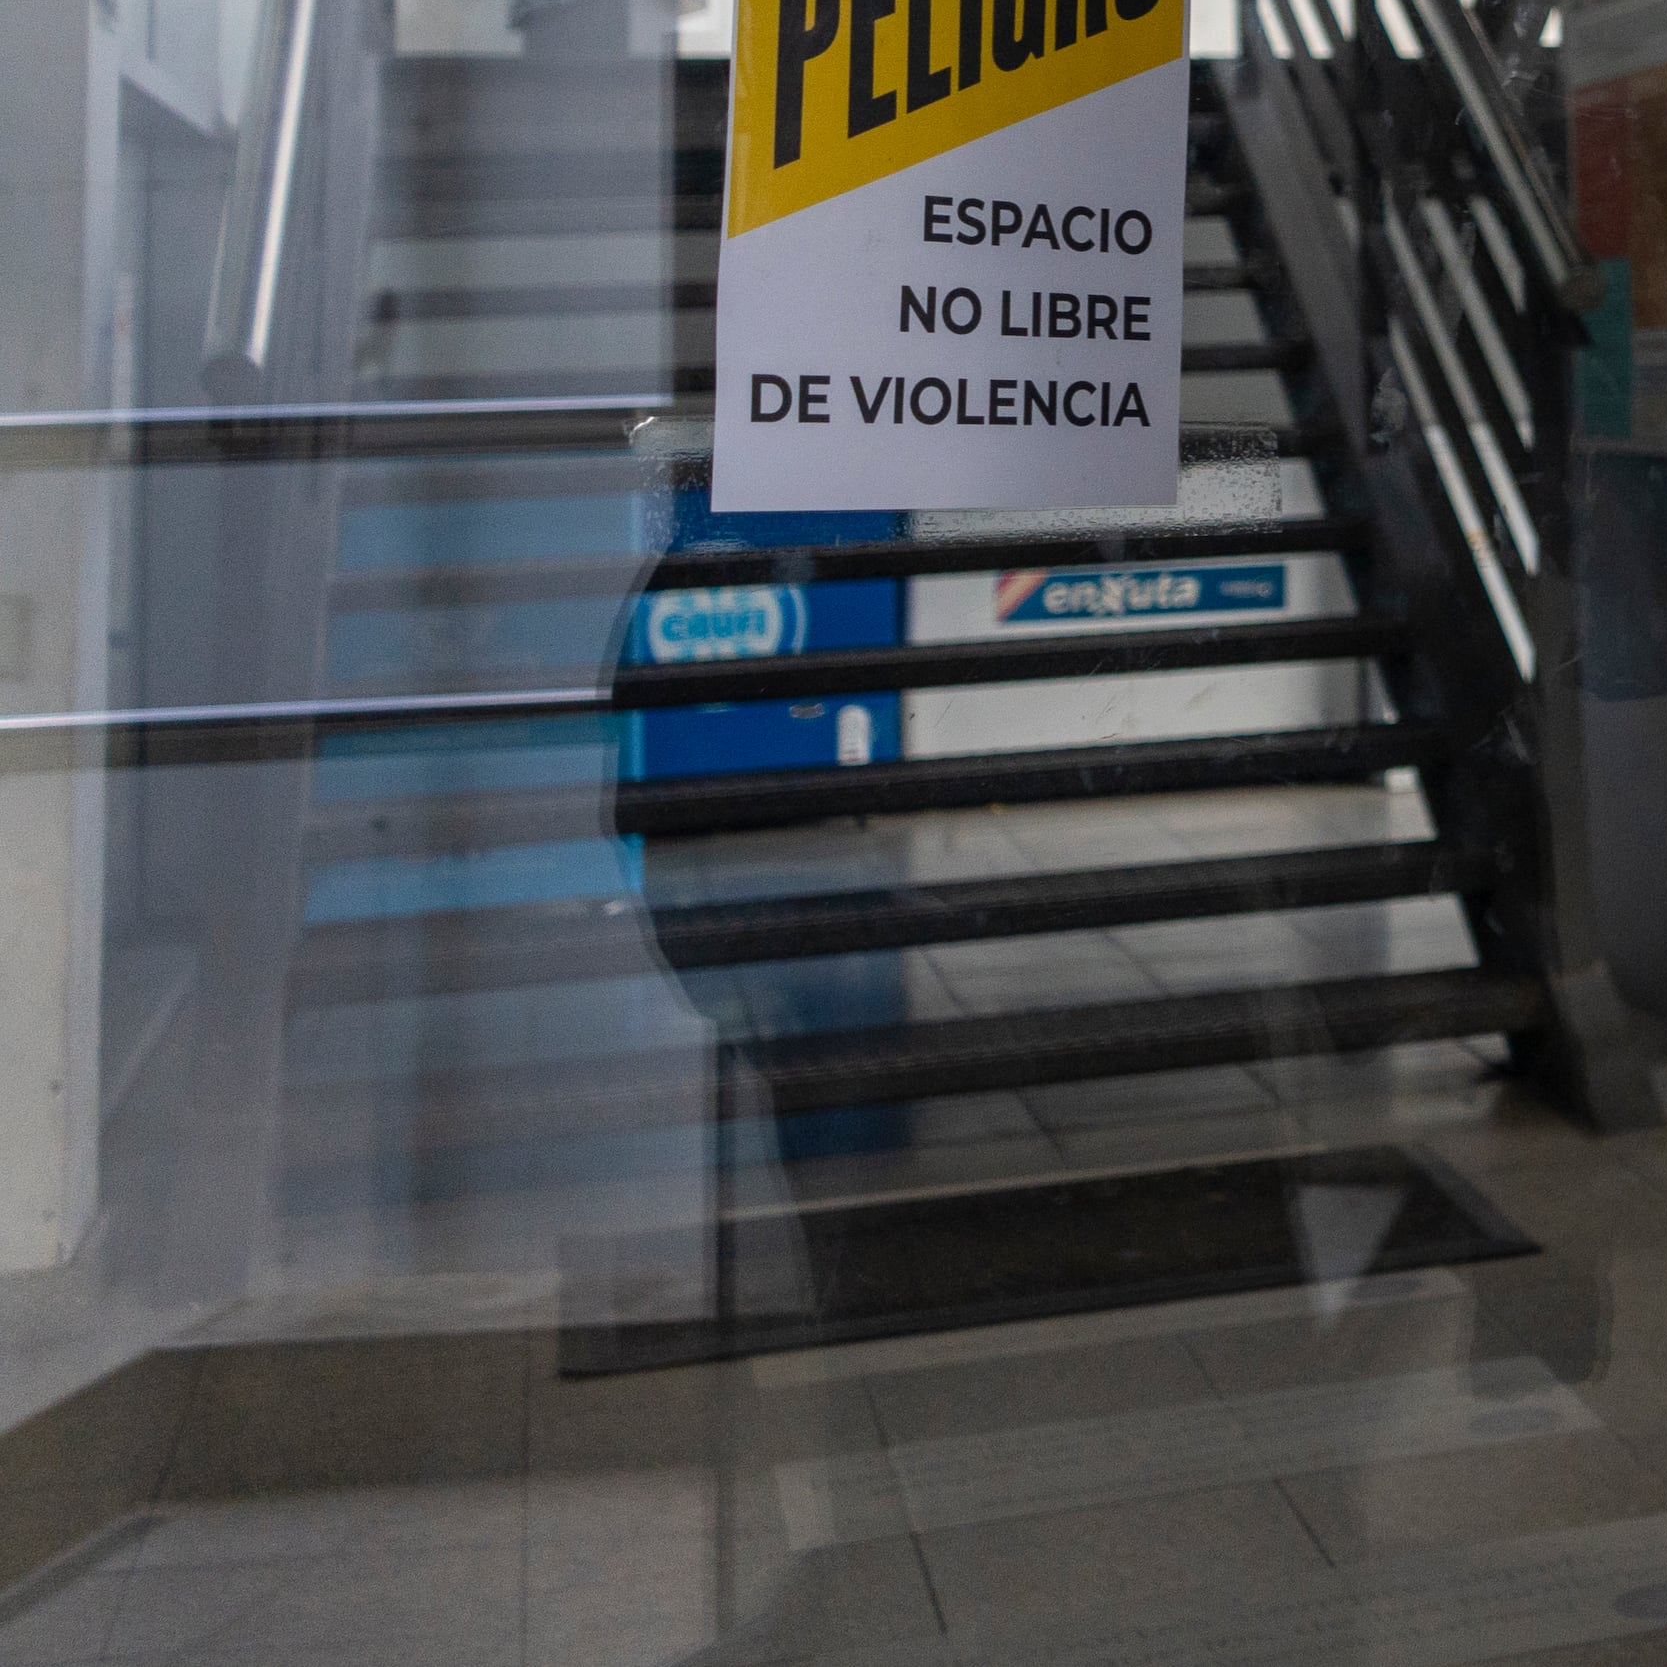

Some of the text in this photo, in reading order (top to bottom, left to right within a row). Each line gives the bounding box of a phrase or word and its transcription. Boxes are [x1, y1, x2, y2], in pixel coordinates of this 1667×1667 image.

[923, 195, 1152, 255] ESPACIO
[900, 285, 1151, 342] NO LIBRE
[751, 373, 1150, 428] DE VIOLENCIA
